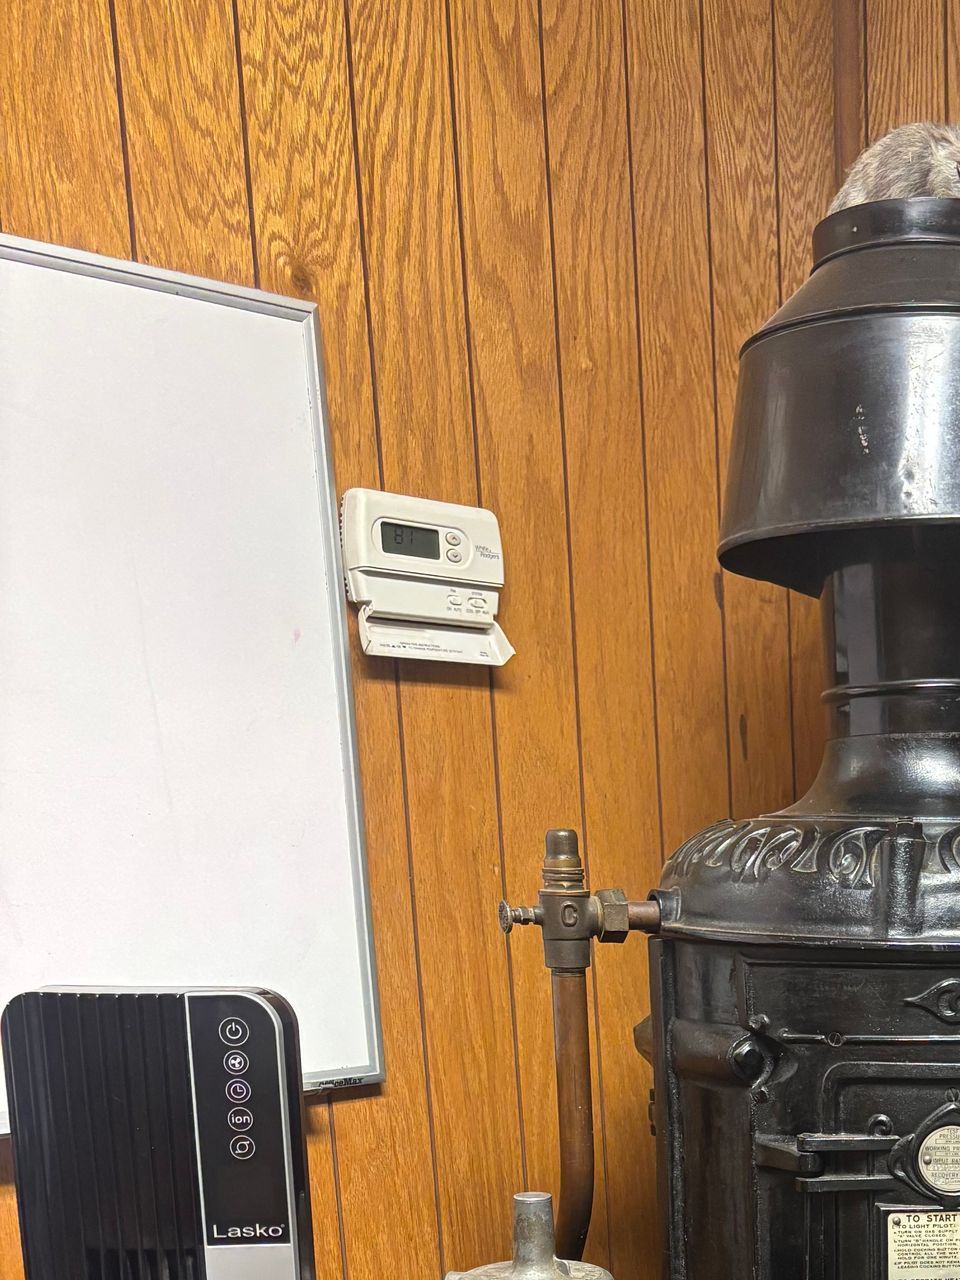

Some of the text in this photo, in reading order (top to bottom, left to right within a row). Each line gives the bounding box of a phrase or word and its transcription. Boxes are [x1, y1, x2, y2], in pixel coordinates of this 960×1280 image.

[231, 1114, 250, 1124] ion
[927, 1214, 957, 1222] START
[213, 1223, 283, 1238] Lasko
